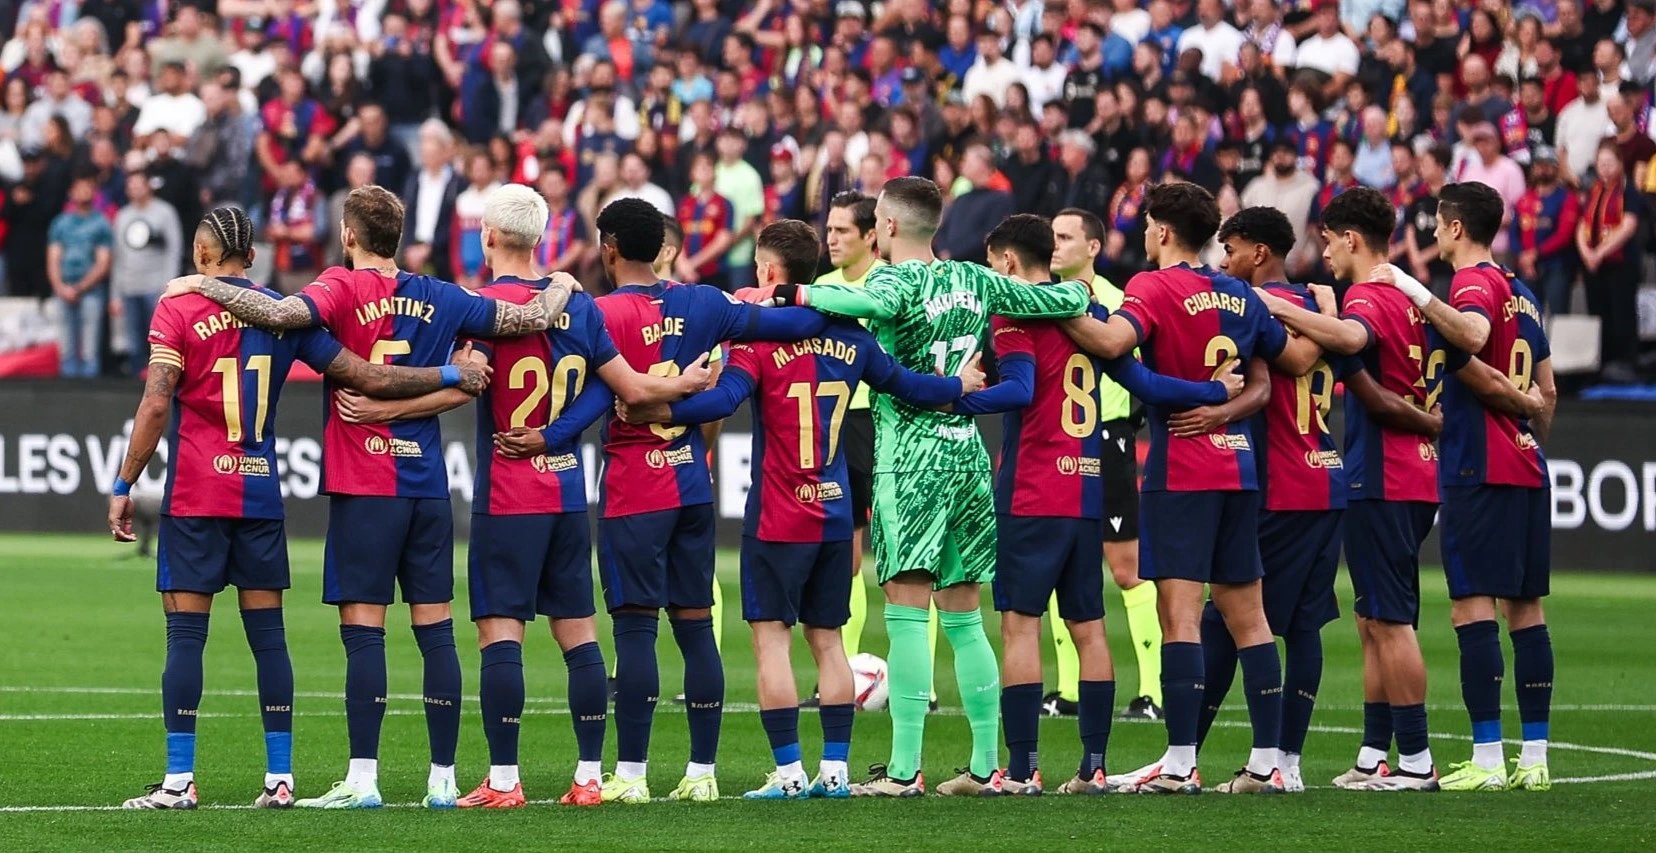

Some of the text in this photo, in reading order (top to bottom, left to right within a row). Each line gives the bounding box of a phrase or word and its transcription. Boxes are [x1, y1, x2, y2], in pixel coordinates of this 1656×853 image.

[1183, 292, 1246, 317] CUBARSÍ
[211, 355, 271, 443] 11
[509, 354, 586, 431] 20
[787, 381, 850, 469] 17
[1061, 353, 1097, 438] 8
[238, 464, 270, 474] ACNUR
